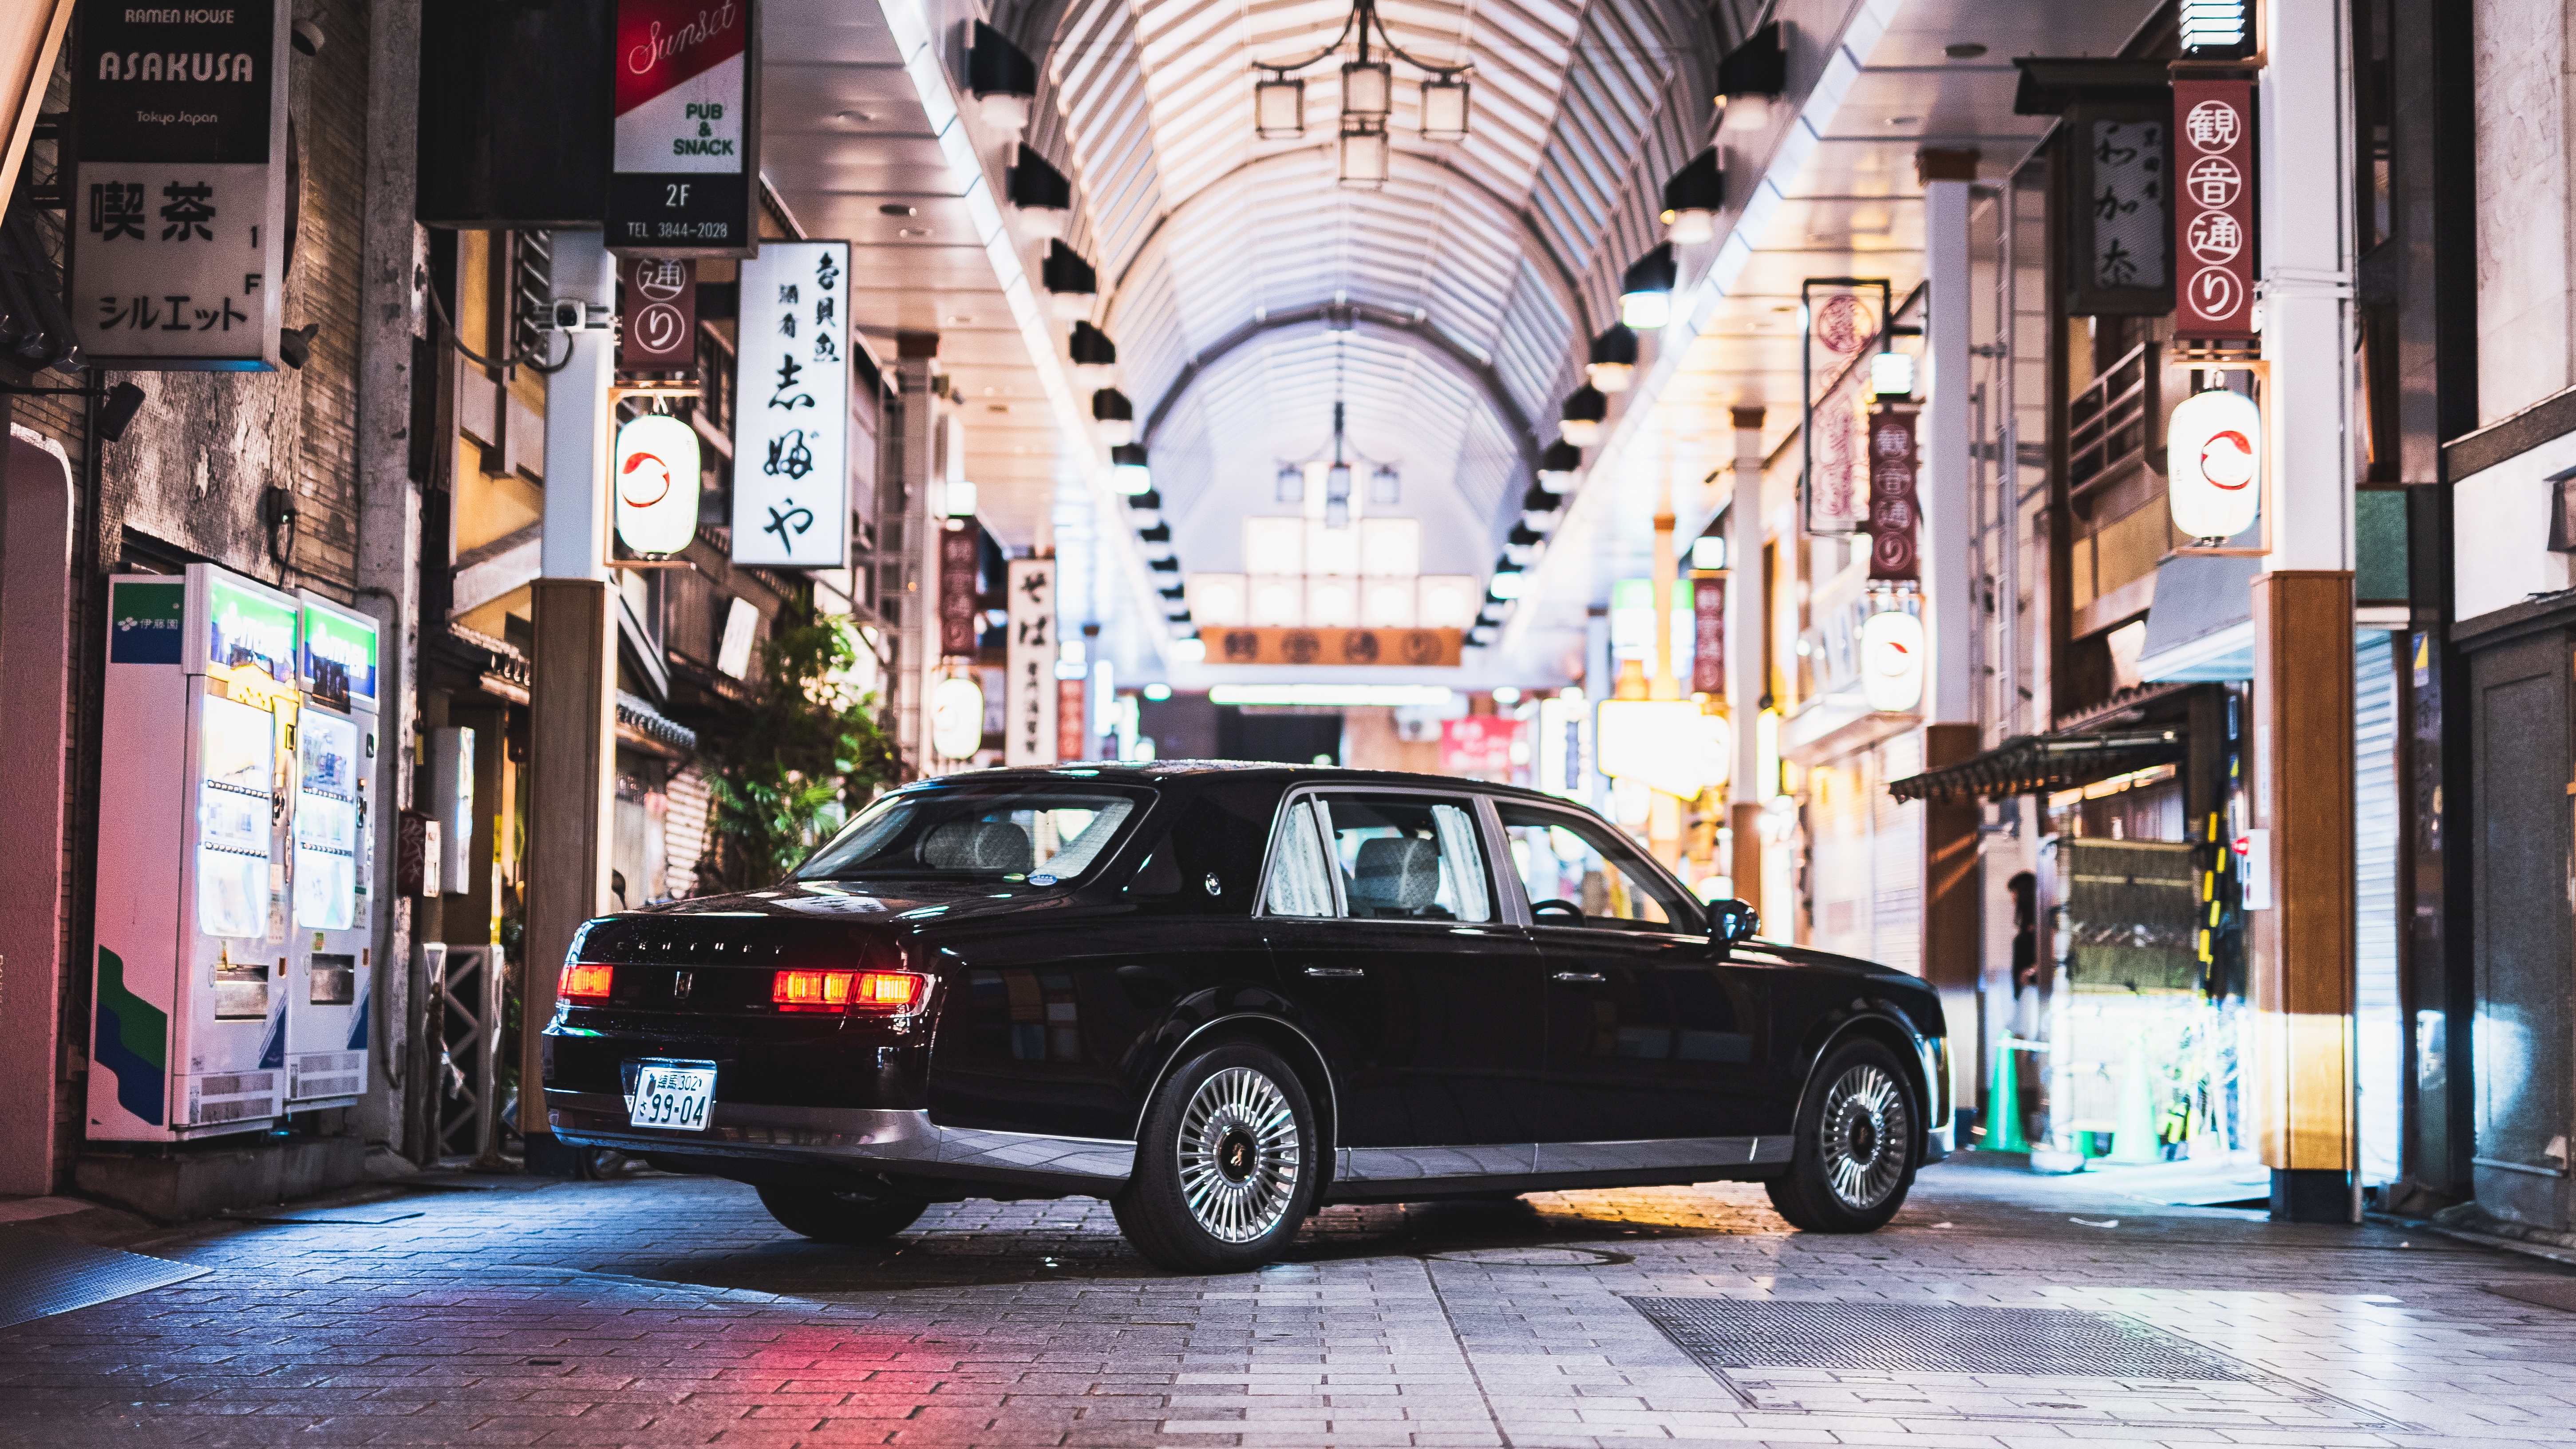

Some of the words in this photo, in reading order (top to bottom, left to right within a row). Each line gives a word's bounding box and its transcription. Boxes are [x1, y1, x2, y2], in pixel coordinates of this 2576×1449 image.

[125, 9, 181, 24] RAMEN
[185, 9, 235, 24] HOUSE
[628, 0, 735, 75] Sunset
[99, 51, 253, 82] ASAKUSA
[137, 111, 175, 125] Tokyo
[178, 111, 217, 126] Japan
[686, 103, 723, 120] PUB
[698, 122, 712, 137] &
[673, 138, 734, 156] SNACK
[666, 183, 691, 207] 2F
[2188, 106, 2239, 315] 観音通り
[90, 181, 216, 242] 喫茶
[628, 221, 649, 238] TEL
[657, 221, 728, 240] 3844-2028
[99, 296, 248, 332] シルエット
[639, 258, 684, 352] 通り
[1876, 425, 1911, 569] 観音通り
[648, 1093, 707, 1126] 99-04
